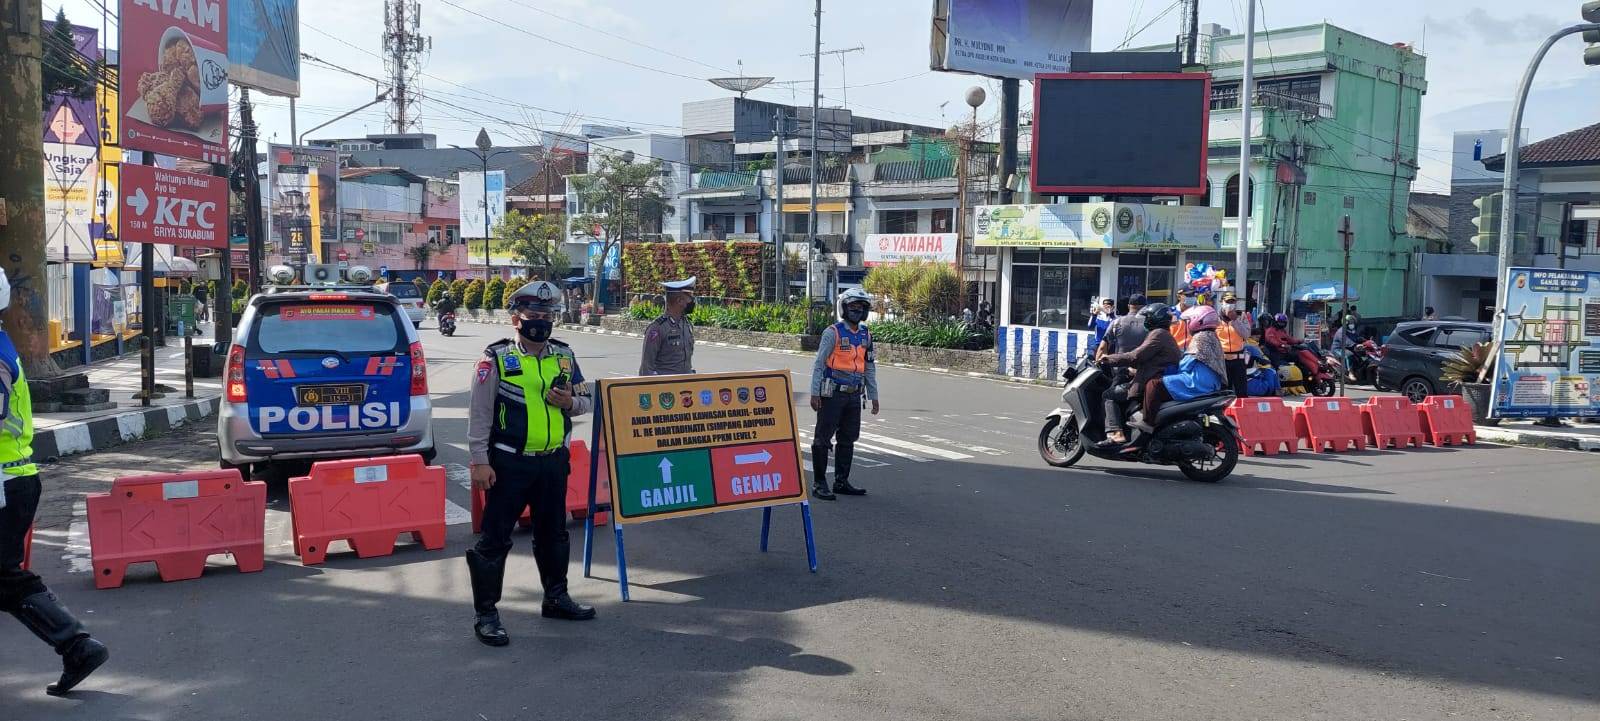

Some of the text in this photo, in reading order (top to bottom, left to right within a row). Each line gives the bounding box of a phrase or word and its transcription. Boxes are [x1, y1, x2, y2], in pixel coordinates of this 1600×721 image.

[56, 165, 82, 176] Saja
[154, 172, 209, 188] Waktunya Makan!
[154, 183, 176, 194] Ayo ke
[154, 196, 216, 228] KFC
[154, 226, 214, 240] GRIYA SUKABUMI
[894, 236, 944, 252] YAMAHA
[260, 402, 400, 432] POLISI
[632, 416, 652, 426] ANDA
[652, 413, 690, 424] MEMASUKI
[692, 410, 726, 422] KAWASAN
[753, 407, 774, 416] GENAP
[633, 428, 642, 438] JL.
[644, 428, 653, 437] RE
[654, 424, 705, 436] MARTADINATA
[707, 421, 742, 432] (SIMPANG
[656, 431, 757, 448] DALAM RANGKA PPKM LEVEL 2
[731, 473, 782, 495] GENAP
[640, 484, 697, 508] GANJIL
